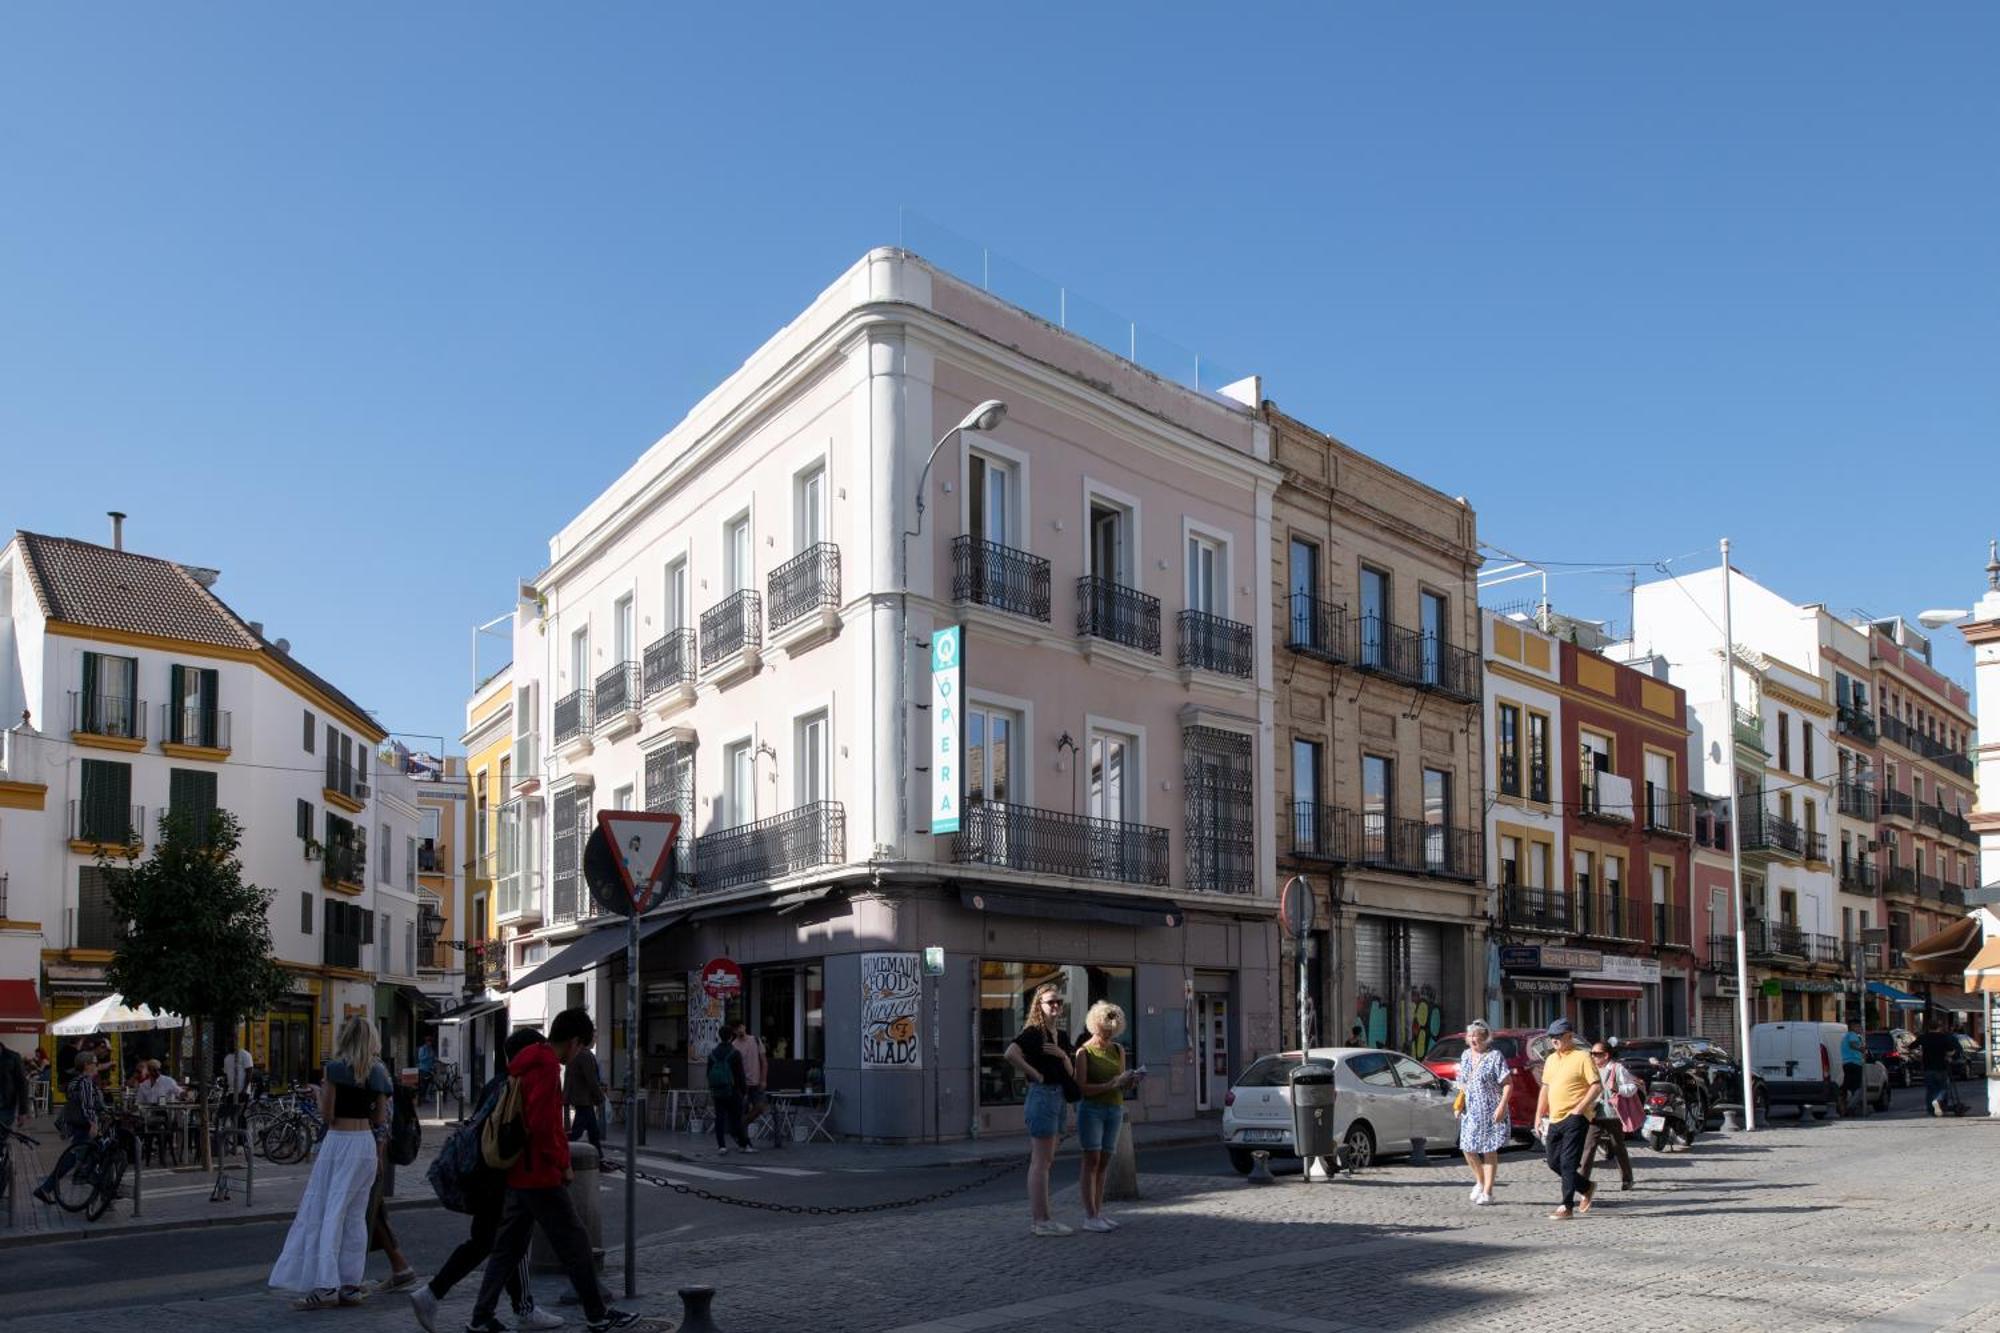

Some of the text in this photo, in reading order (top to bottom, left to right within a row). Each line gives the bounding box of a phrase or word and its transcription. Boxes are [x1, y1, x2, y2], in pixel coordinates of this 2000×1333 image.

[863, 956, 919, 985] HOMEMADE
[870, 972, 910, 991] FOOD
[863, 1034, 917, 1065] SALADS
